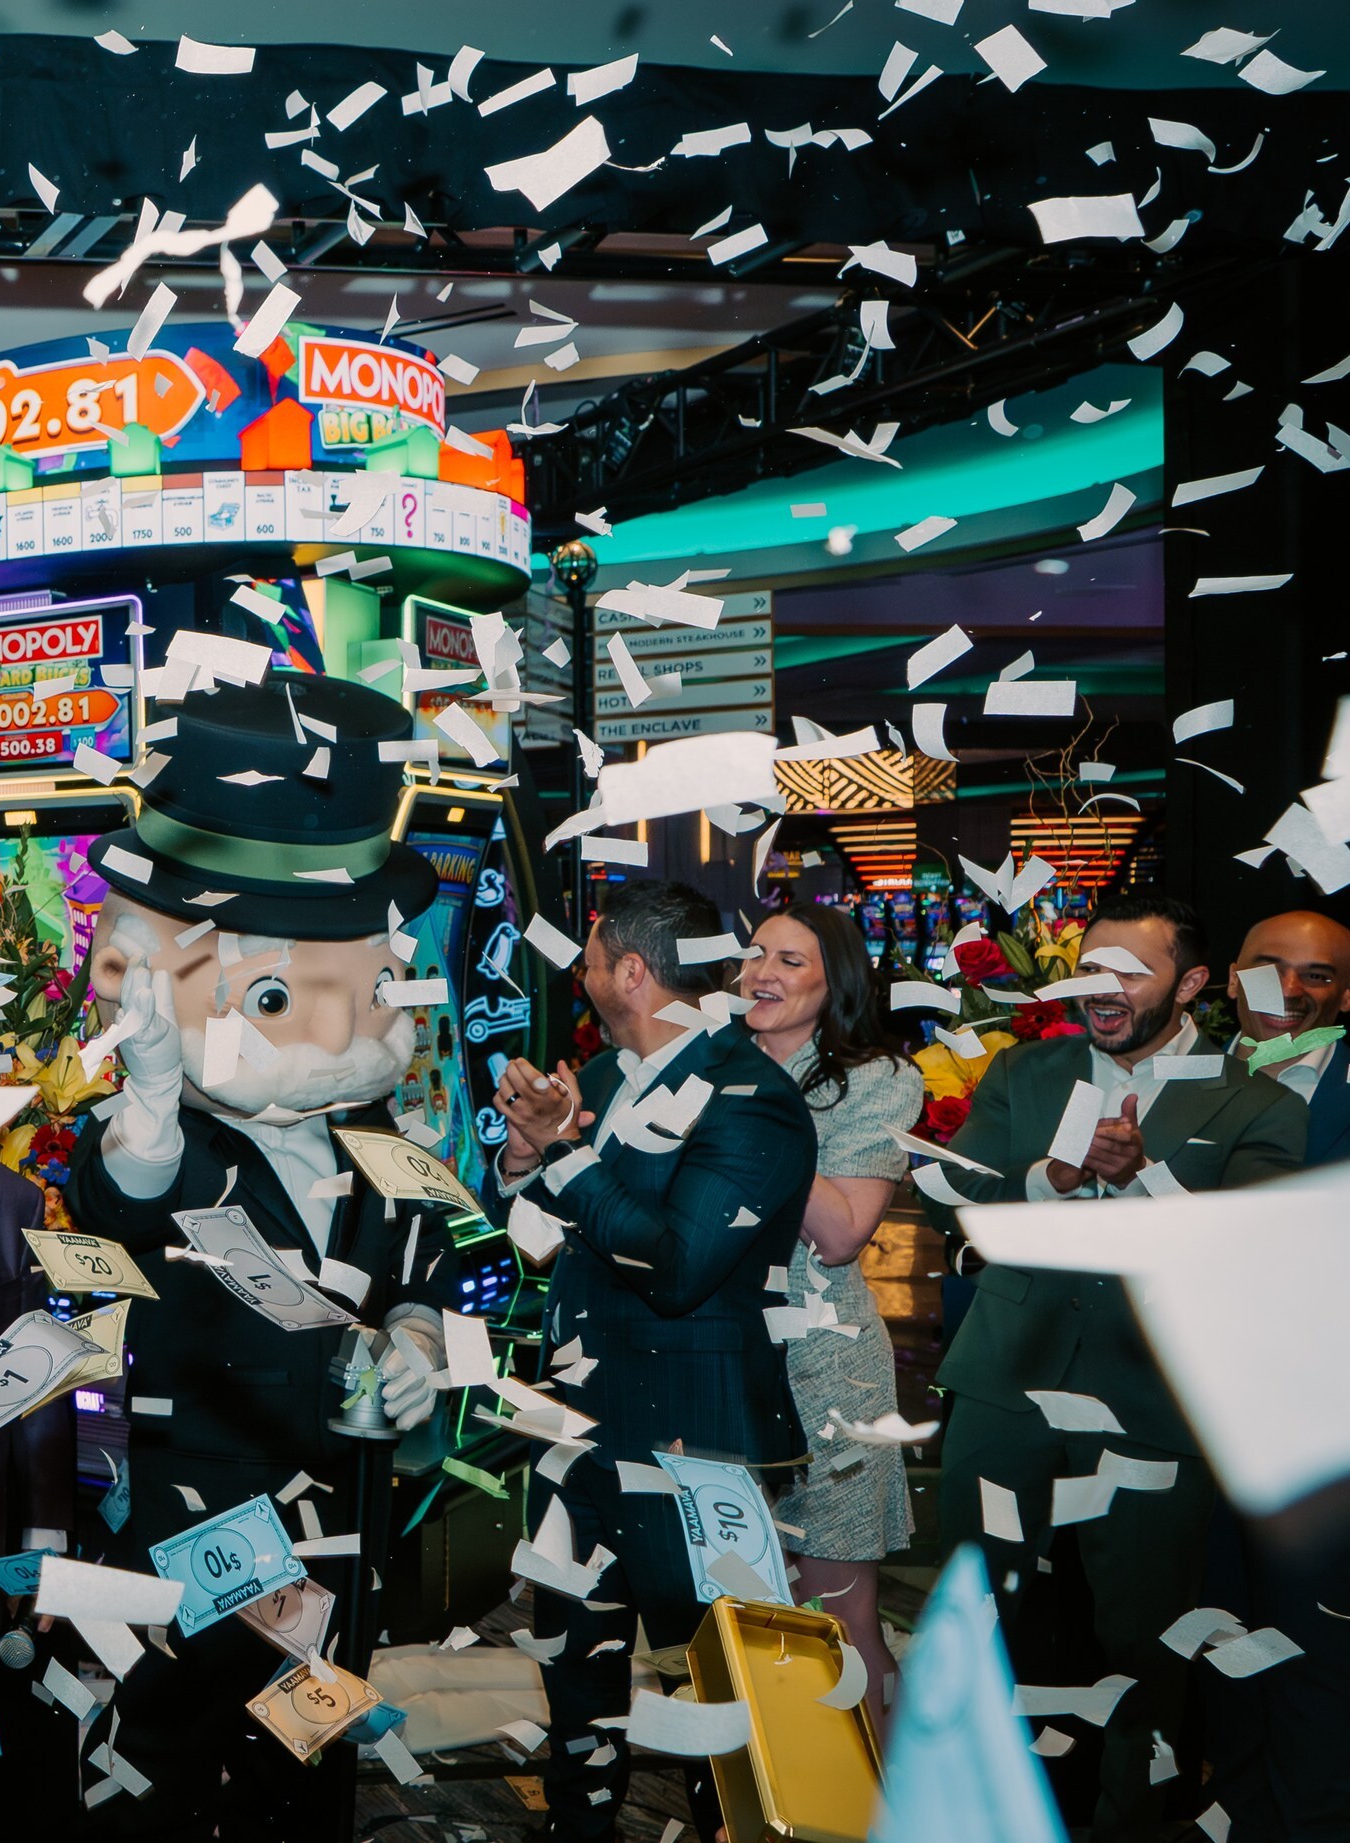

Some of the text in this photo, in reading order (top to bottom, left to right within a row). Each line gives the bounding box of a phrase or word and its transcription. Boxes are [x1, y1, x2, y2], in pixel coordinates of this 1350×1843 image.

[310, 347, 444, 424] MONOPO
[321, 410, 369, 444] BIG
[132, 529, 153, 539] 1750
[174, 527, 192, 537] 500
[256, 524, 274, 534] 600
[15, 540, 35, 551] 1600
[53, 535, 73, 547] 1600
[430, 626, 477, 659] MONOP
[677, 629, 745, 644] STEAKHOUSE
[654, 661, 703, 677] SHOPS
[600, 719, 701, 736] THE ENCLAVE
[74, 1252, 113, 1275] $20
[214, 1265, 258, 1306] YAAMAVA
[246, 1273, 272, 1290] $1
[712, 1501, 749, 1543] $10
[204, 1545, 242, 1579] $10
[280, 1667, 311, 1692] YAAMAV
[306, 1687, 337, 1708] $5
